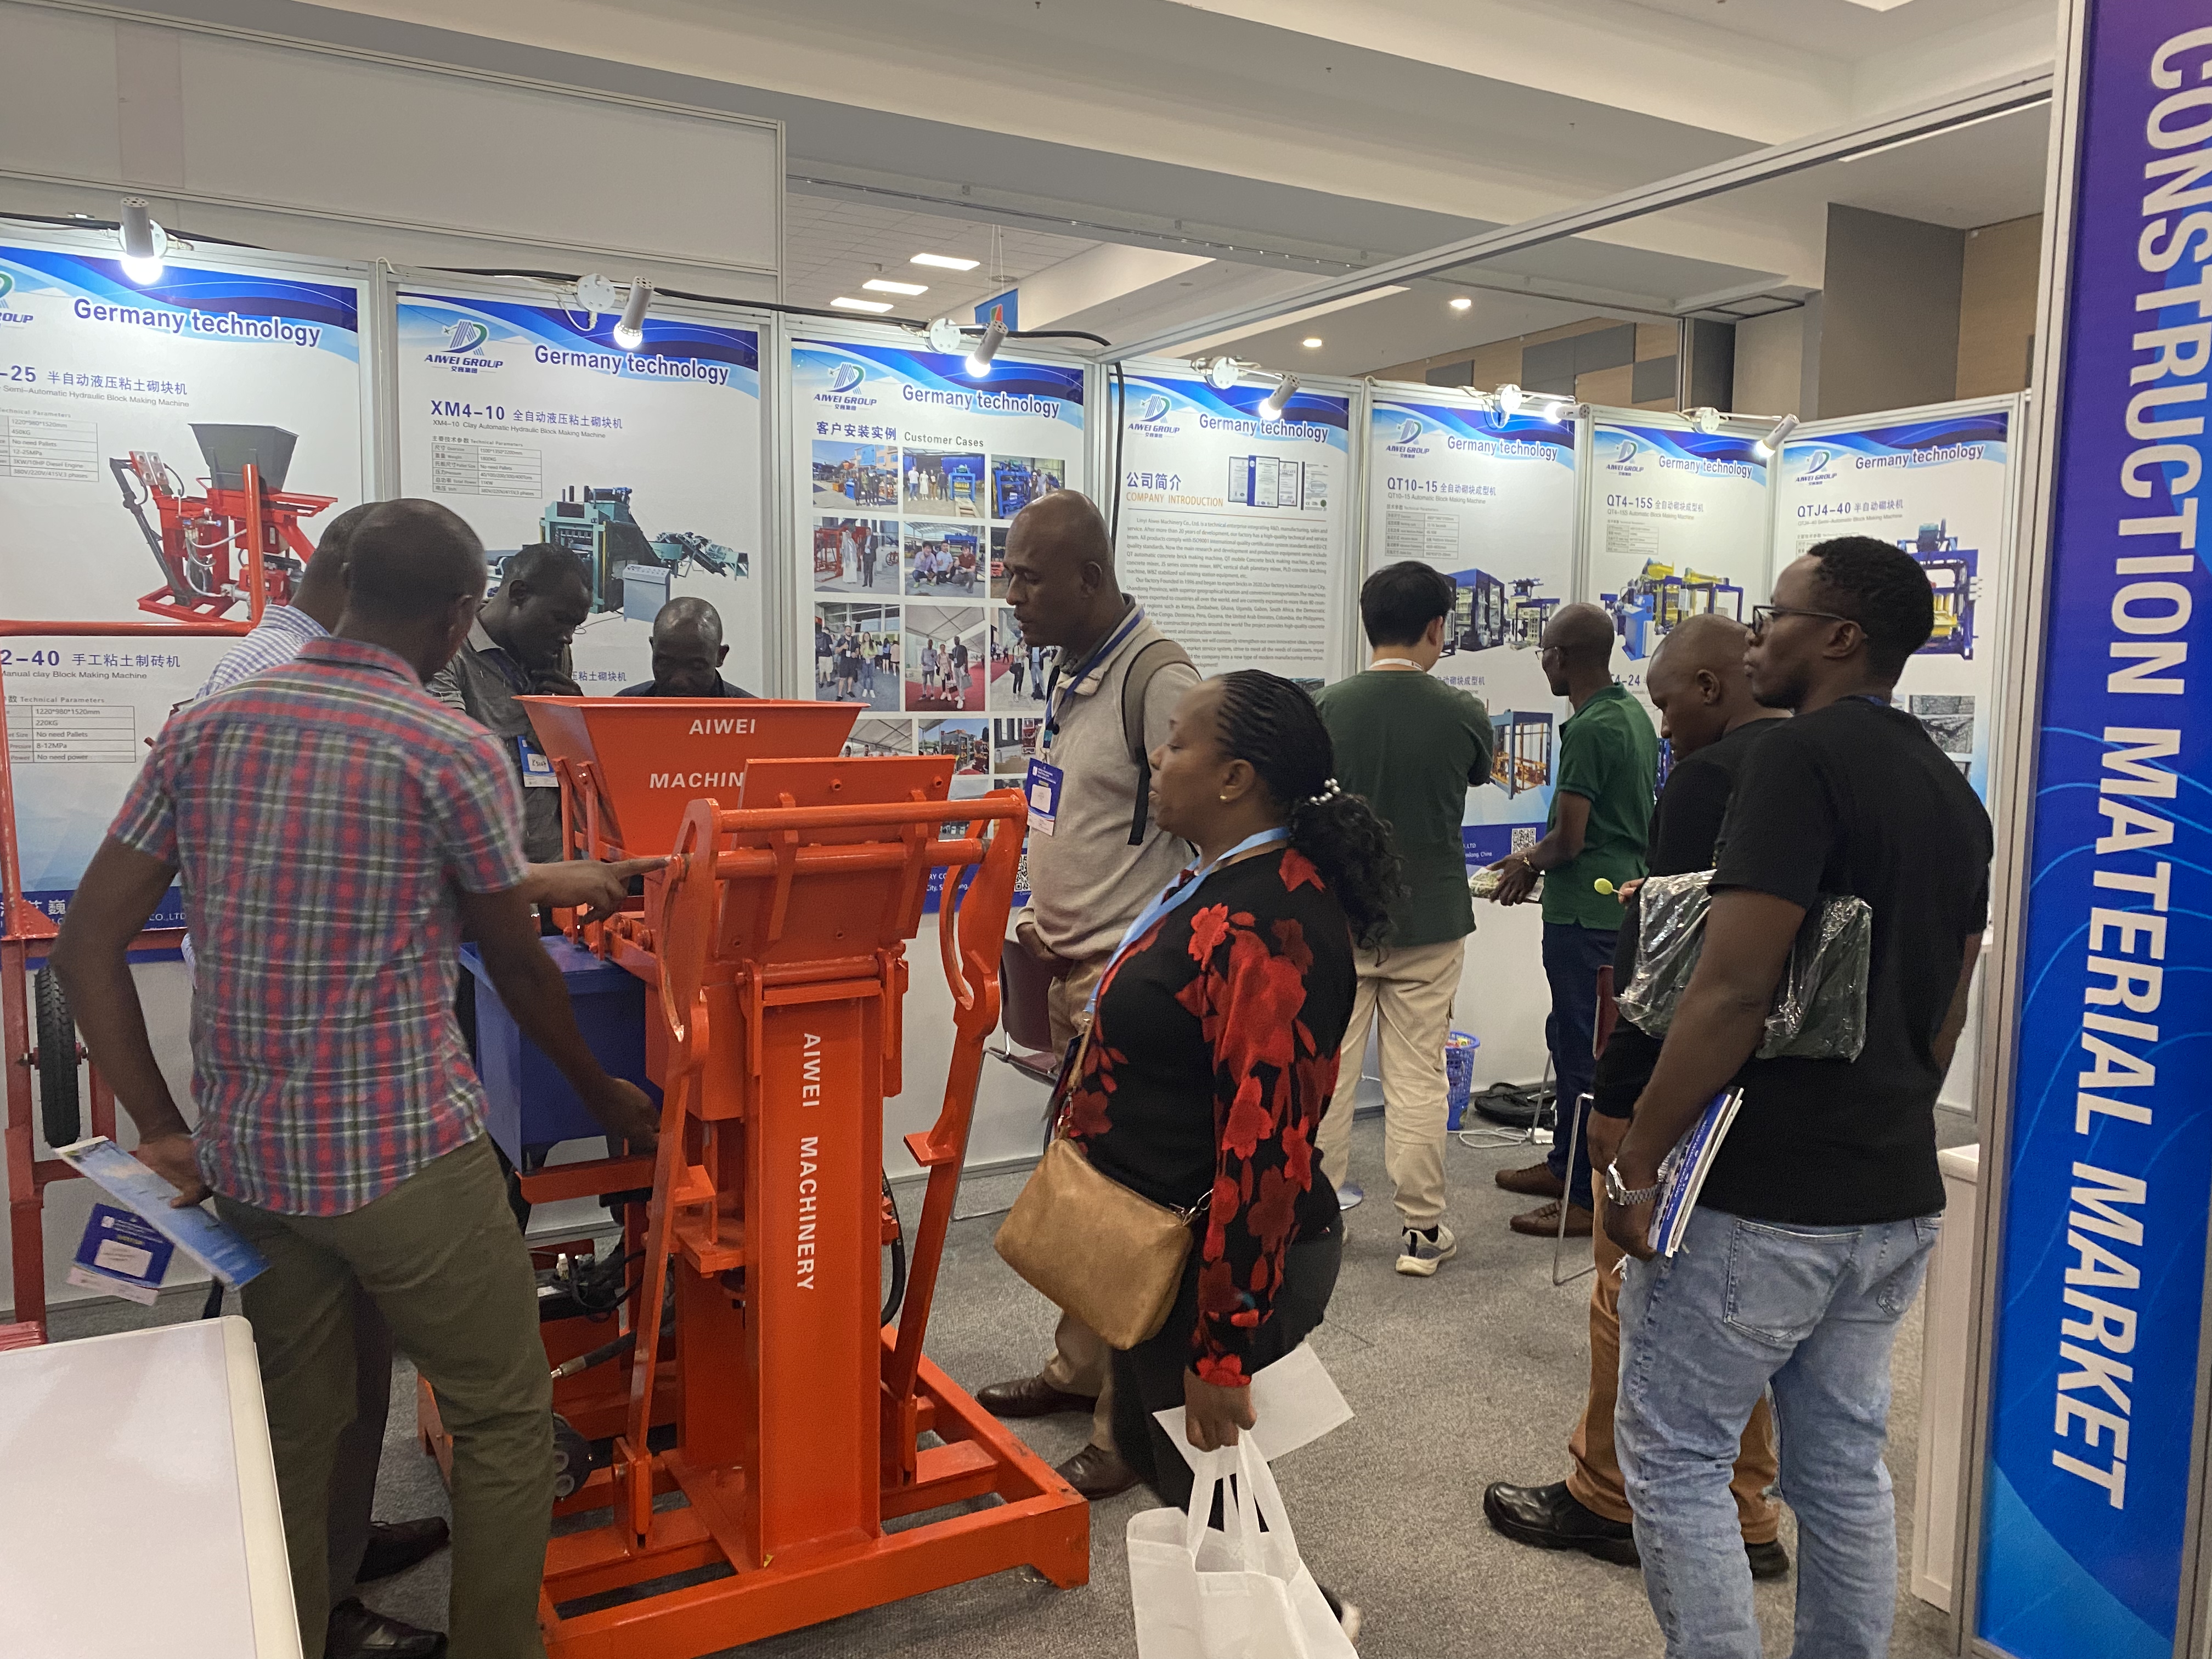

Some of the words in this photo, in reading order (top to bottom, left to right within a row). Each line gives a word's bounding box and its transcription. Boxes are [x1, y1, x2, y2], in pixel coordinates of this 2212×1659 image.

[74, 298, 184, 334] Germany
[192, 308, 321, 347] technology
[424, 354, 460, 364] AIWEI
[462, 358, 503, 368] GROUP
[535, 345, 622, 375] Germany
[628, 352, 730, 385] technology
[2106, 26, 2212, 696] CONSTRUCTION
[47, 370, 188, 395] 半自动液压粘土砌块机
[69, 391, 105, 400] Hydraulic
[107, 393, 127, 402] Block
[129, 396, 156, 406] Making
[159, 398, 189, 407] Machine
[813, 393, 844, 403] AIWEI
[844, 396, 877, 406] GROUP
[902, 384, 973, 411] Germany
[977, 391, 1060, 419] technology
[430, 400, 505, 420] XM4-10
[512, 409, 623, 430] 全自动液压粘土砌块机
[478, 423, 509, 431] Automatic
[511, 425, 539, 434] Hydraulic
[558, 429, 580, 438] Making
[816, 421, 897, 441] 客户安装实例
[904, 431, 952, 445] Customer
[956, 435, 984, 448] Cases
[1128, 422, 1152, 432] AIWEI
[1153, 425, 1180, 434] GROUP
[1199, 414, 1257, 437] Germany
[1261, 420, 1328, 442] technology
[1448, 436, 1497, 456] Germany
[1499, 440, 1558, 461] technology
[1855, 455, 1909, 470] Germany
[1912, 445, 1984, 464] technology
[1659, 455, 1700, 473] Germany
[1703, 458, 1752, 478] technology
[1126, 471, 1182, 492] 公司简介
[1387, 477, 1438, 493] QT10-15
[1795, 475, 1814, 483] AIWEI
[1815, 473, 1837, 481] GROUP
[1126, 492, 1164, 503] COMPANY
[1168, 495, 1223, 507] INTRODUCTION
[1440, 483, 1496, 496] 全自动砌块成型机
[1607, 494, 1653, 509] QT4-15S
[1797, 502, 1851, 518] QTJ4-40
[71, 653, 180, 668] 手工粘土制砖机
[78, 672, 109, 680] Making
[689, 718, 756, 736] AIWEI
[2075, 726, 2181, 1136] MATERIAL
[802, 1032, 821, 1107] AIWEI
[796, 1136, 819, 1290] MACHINERY
[2051, 1162, 2148, 1510] MARKET
